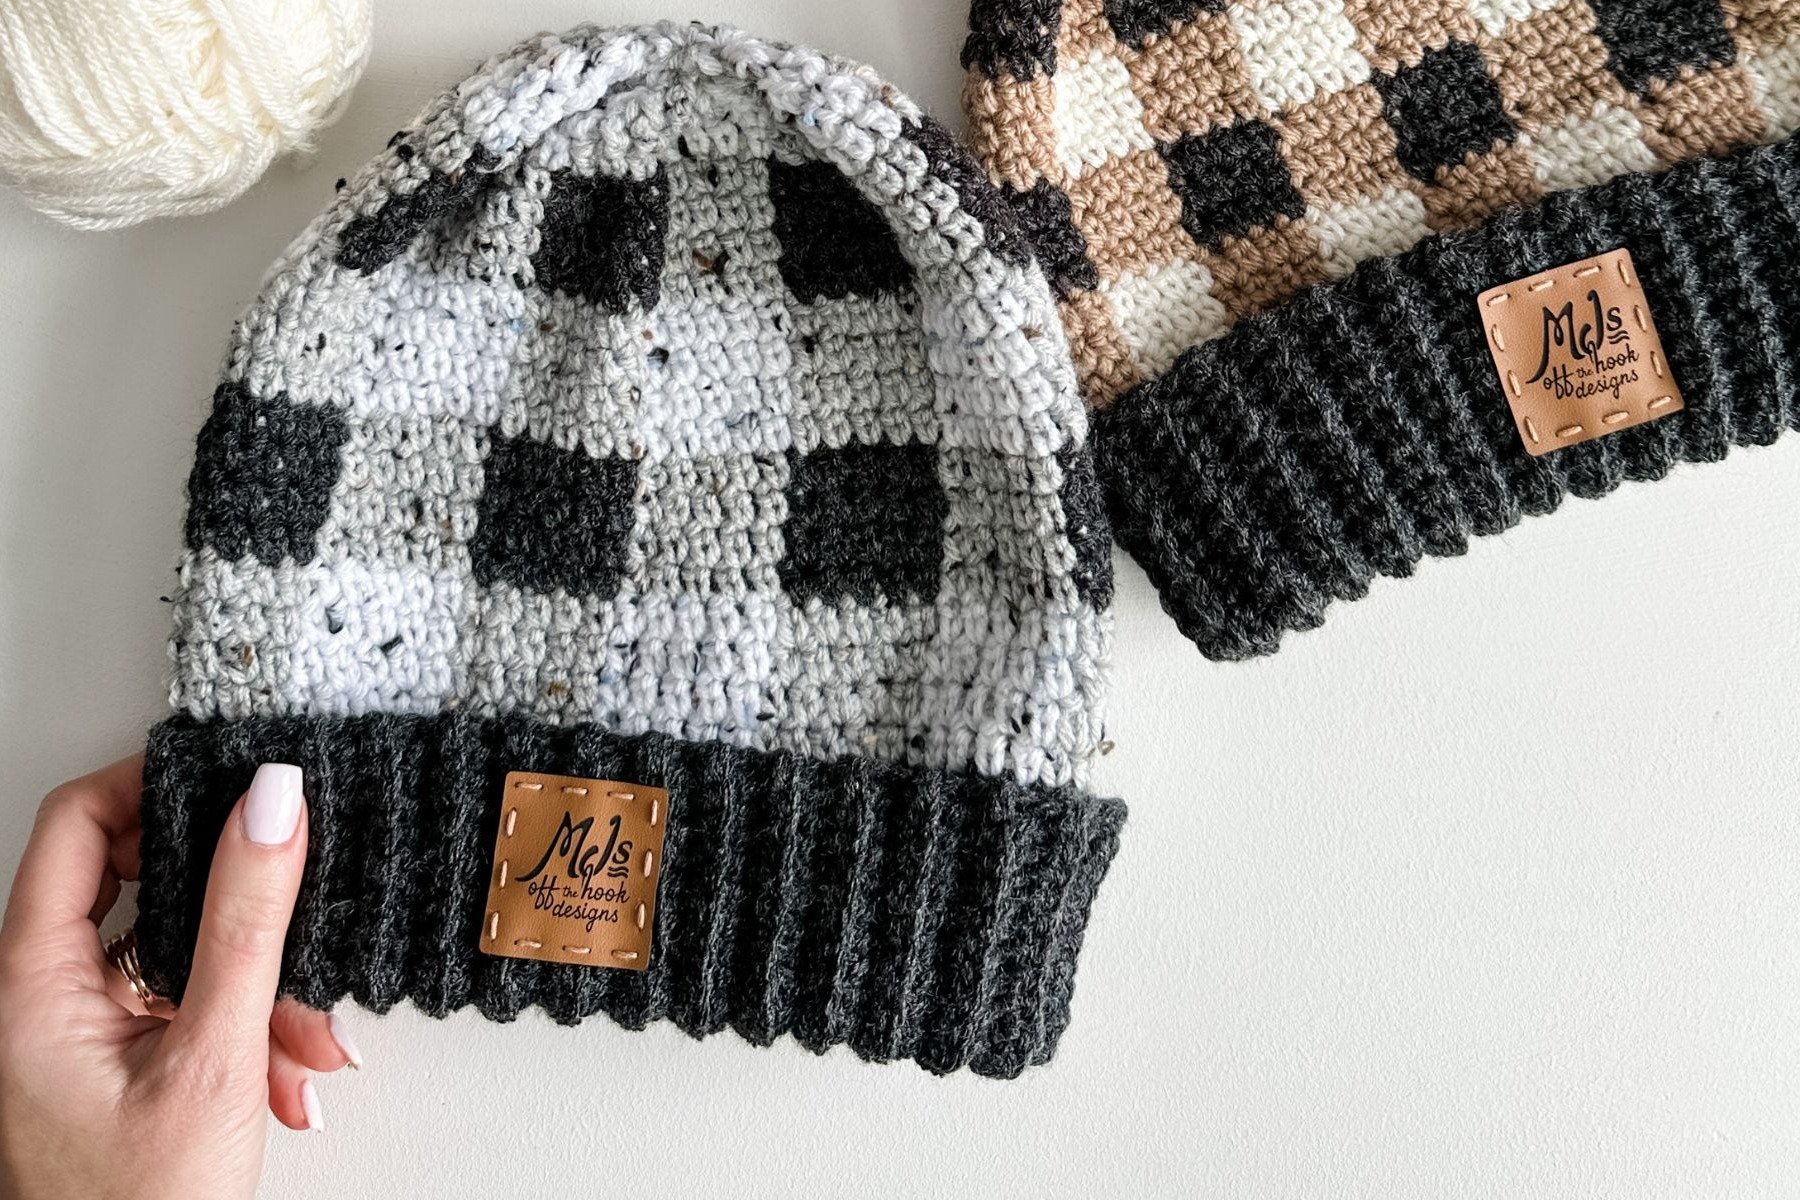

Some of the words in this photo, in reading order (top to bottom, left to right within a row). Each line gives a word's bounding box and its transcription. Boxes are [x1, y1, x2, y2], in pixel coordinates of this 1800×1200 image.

[1543, 363, 1575, 399] off
[1575, 366, 1593, 378] the
[1588, 341, 1640, 374] hook
[1575, 369, 1639, 400] designs
[528, 874, 561, 911] off
[562, 886, 579, 898] the
[581, 864, 630, 903] hook
[552, 901, 619, 932] designs
